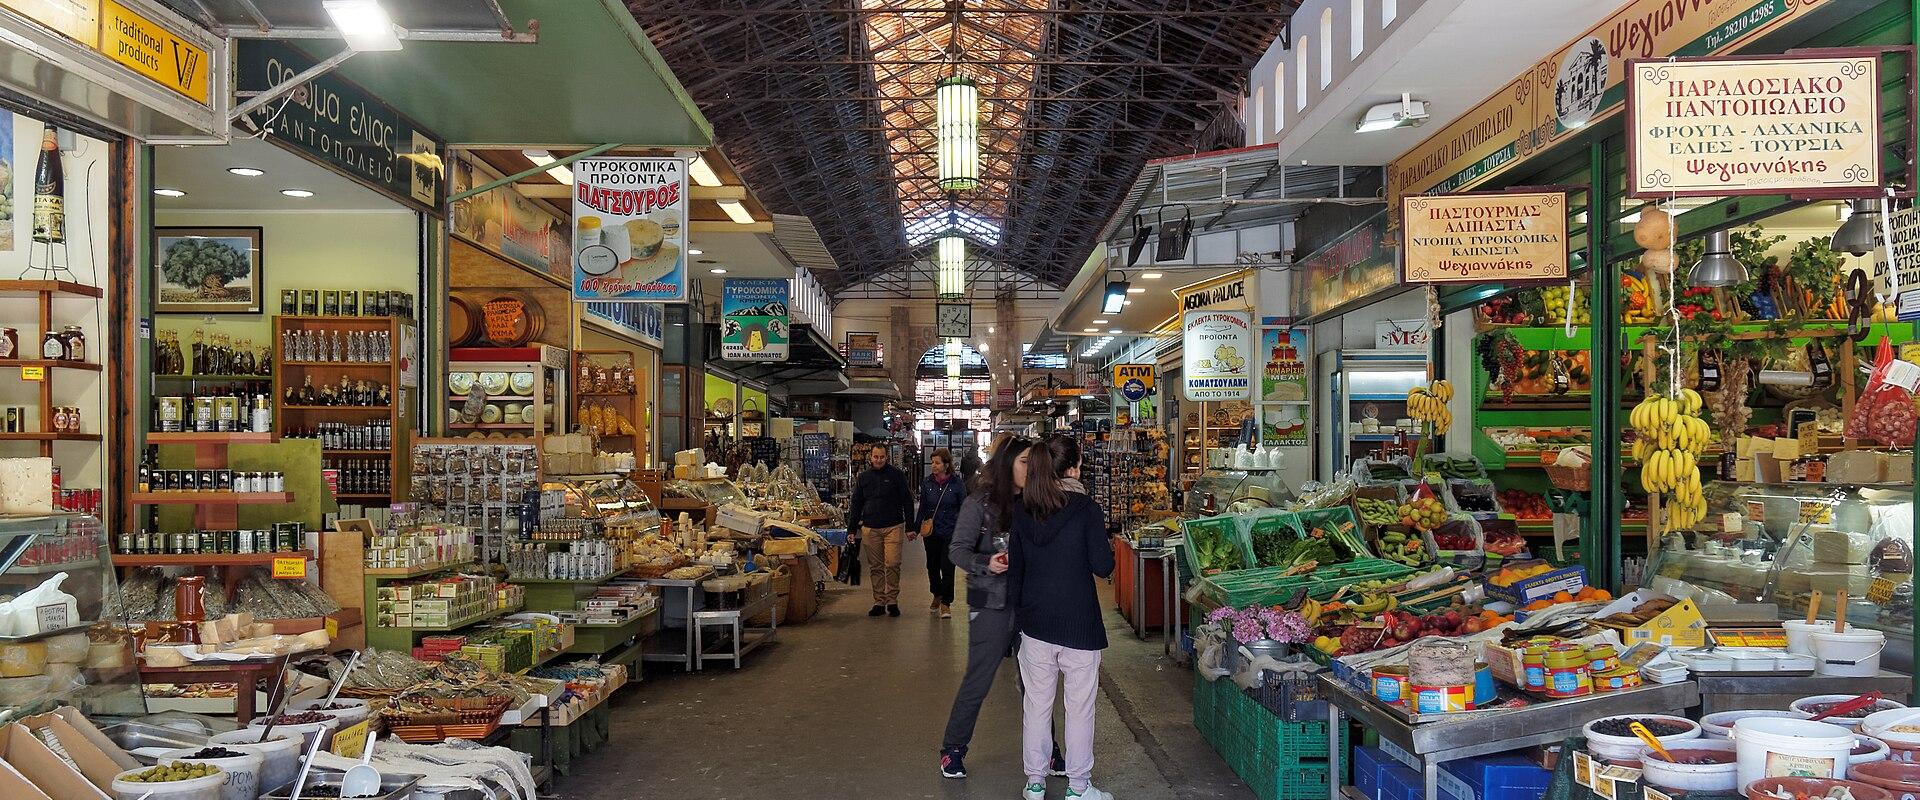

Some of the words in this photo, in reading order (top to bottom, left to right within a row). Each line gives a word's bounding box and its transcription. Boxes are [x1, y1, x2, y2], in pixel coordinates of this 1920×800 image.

[1705, 34, 1723, 48] Τηλ.
[1724, 15, 1748, 39] 28210
[1749, 1, 1774, 27] 42985
[115, 15, 163, 55] traditional
[118, 39, 159, 71] products
[1668, 76, 1843, 97] ΠΑΡΑΔΟΣΙΑΚΟ
[1665, 97, 1846, 118] ΠΑΝΤΟΠΩΛΕΙΟ
[350, 102, 393, 162] ελιας
[1649, 123, 1735, 139] ΦΡΟΥΤΑ
[1753, 120, 1863, 137] ΛΑΧΑΝΙΚΑ
[265, 105, 393, 183] ΠΑΝΤΟΠΩΛΕΙΟ
[1400, 145, 1449, 192] ΠΑΡΑΔΟΣΙΑΚΟ
[1451, 104, 1513, 161] ΠΑΝΤΟΠΩΛΕΙΟ
[1668, 140, 1733, 155] ΕΛΙΕΣ
[1750, 138, 1844, 153] ΤΟΥΡΣΙΑ
[580, 161, 677, 172] ΤΥΡΟΚΟΜΙΚΑ
[1458, 165, 1477, 185] ΕΛΙΕΣ
[1483, 147, 1511, 172] ΤΟΥΡΣΙΑ
[1686, 155, 1828, 182] Ψεγιαννάκης
[590, 172, 667, 184] ΠΡΟΪΟΝΤΑ
[577, 180, 681, 216] ΠΑΤΣΟΥΡΟΣ
[1430, 204, 1541, 220] ΠΑΣΤΟΥΡΜΑΣ
[1445, 219, 1526, 233] ΑΛΙΠΑΣΤΑ
[1413, 236, 1462, 247] ΝΤΟΠΙΑ
[1469, 234, 1558, 245] ΤΥΡΟΚΟΜΙΚΑ
[1890, 241, 1920, 257] ΑΛΒΑΣ
[1452, 246, 1520, 256] ΚΑΠΝΙΣΤΑ
[1438, 258, 1533, 276] Ψεγιαννάκης
[580, 278, 599, 293] 100
[725, 286, 786, 294] ΤΥΡΟΚΟΜΙΚΑ
[1184, 290, 1212, 311] AGORA
[1212, 281, 1245, 304] PALACE
[1187, 314, 1212, 331] ΕΚΛΕΚΤΑ
[1213, 314, 1248, 331] ΤΥΡΟΚΟΜΙΚΑ
[1119, 366, 1151, 377] ATM
[1189, 379, 1248, 388] ΚΟΜΑΤΣΟΥΛΑΚΗ
